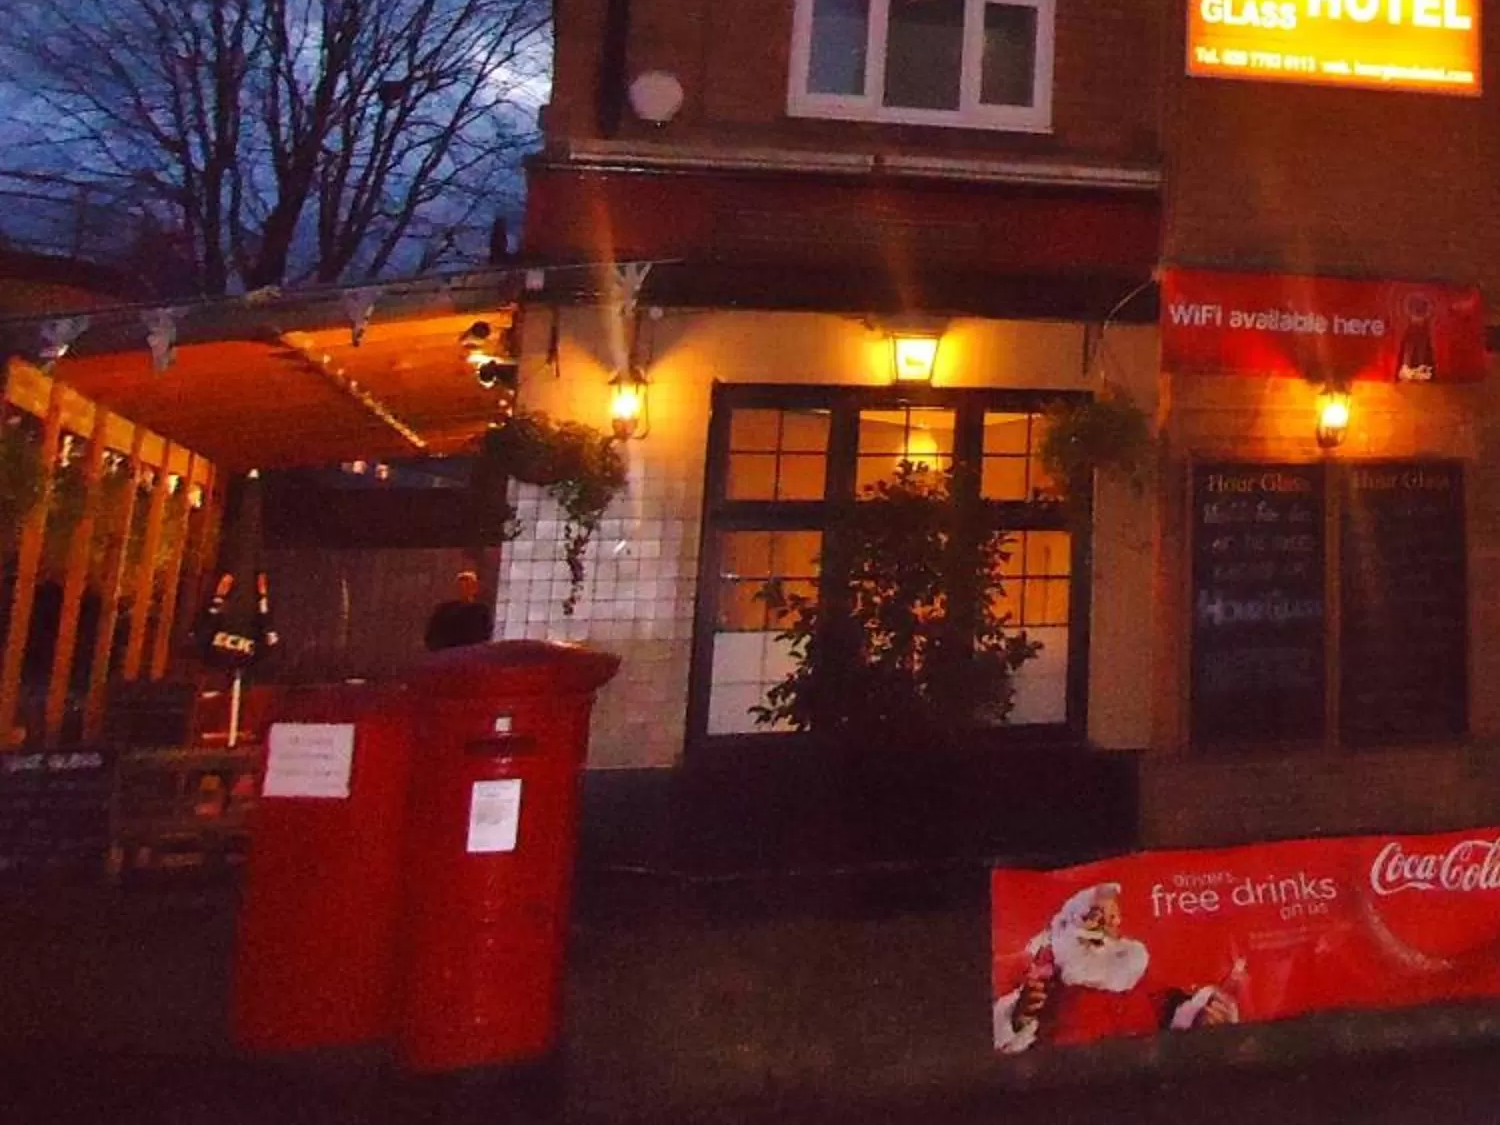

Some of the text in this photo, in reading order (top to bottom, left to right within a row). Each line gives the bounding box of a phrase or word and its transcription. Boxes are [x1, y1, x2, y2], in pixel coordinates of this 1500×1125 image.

[1168, 303, 1385, 336] WiFi available here
[1151, 872, 1337, 916] free drinks
[1279, 901, 1329, 920] on us
